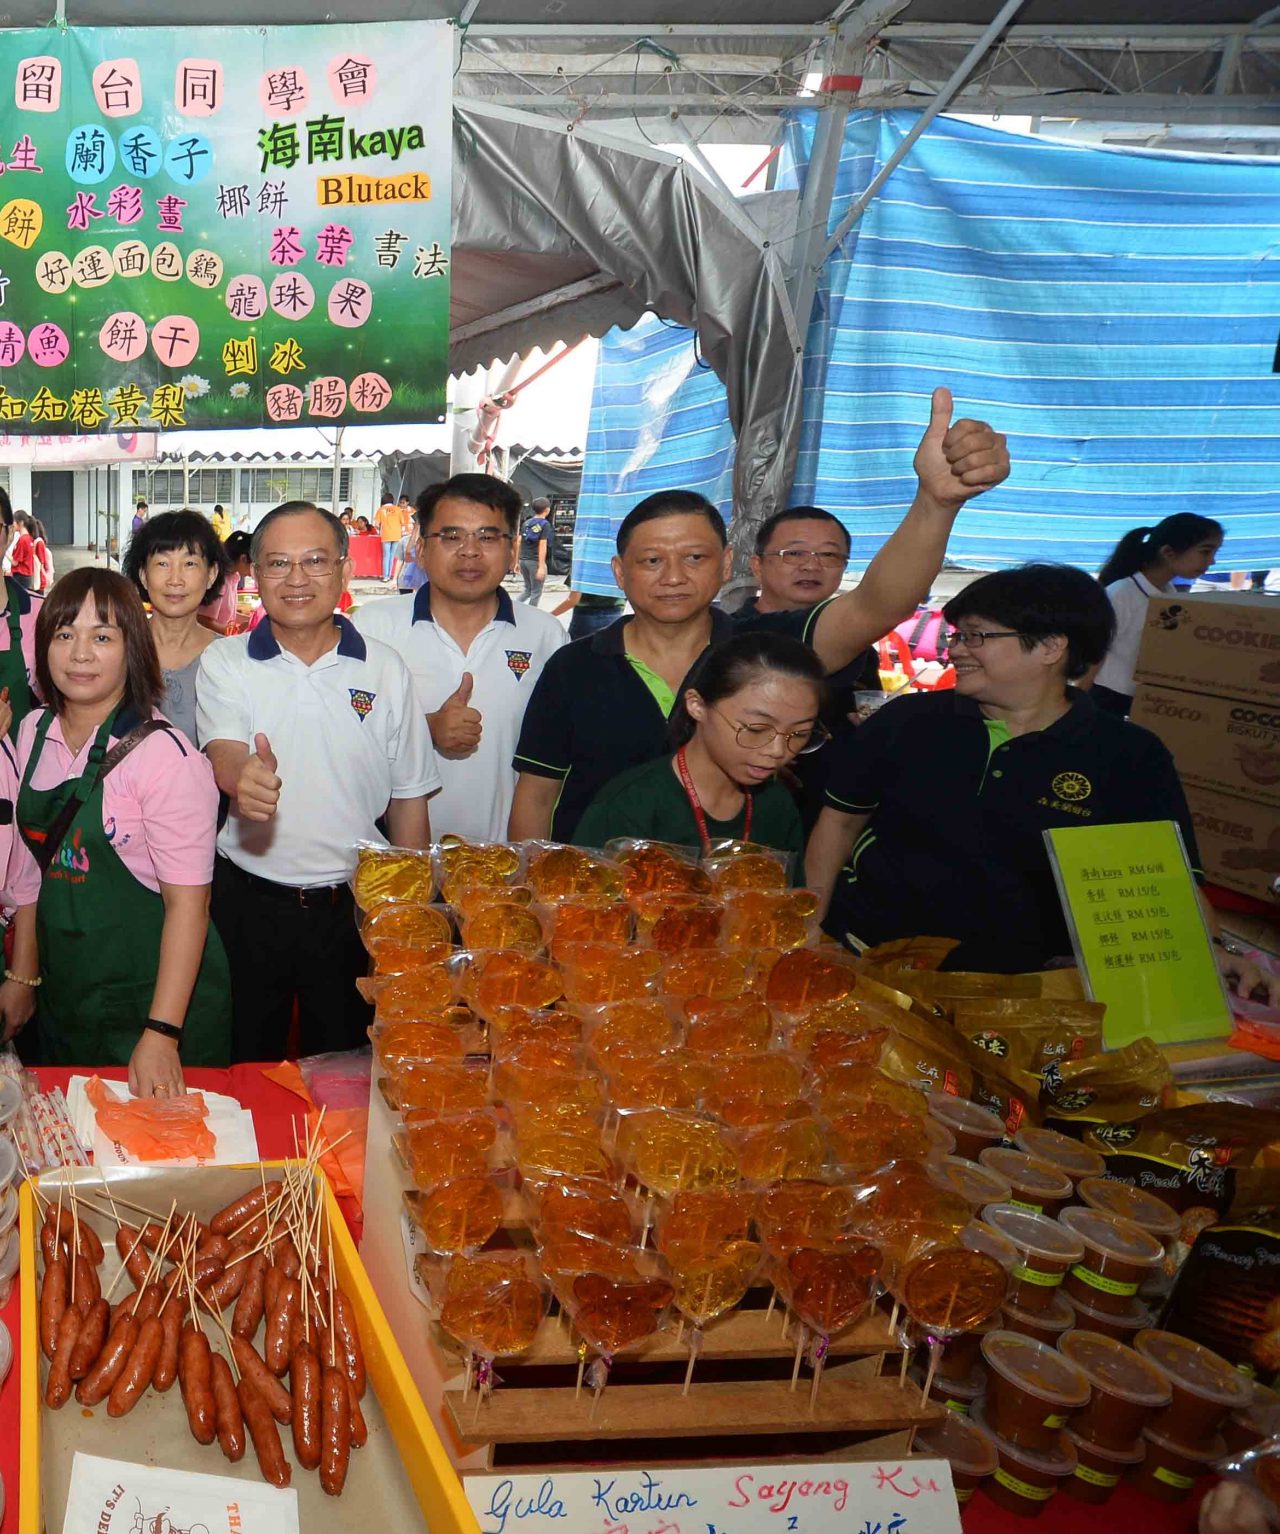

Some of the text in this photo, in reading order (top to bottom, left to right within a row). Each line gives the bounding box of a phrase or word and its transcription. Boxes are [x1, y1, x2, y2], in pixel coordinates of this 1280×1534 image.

[71, 128, 208, 180] 蘭香子
[68, 186, 187, 230] 水彩畫
[217, 181, 289, 219] 椰餅
[321, 174, 427, 206] Blutack
[272, 226, 354, 266] 茶葉
[375, 230, 448, 277] 書法
[230, 282, 367, 320] 龍珠果
[106, 321, 190, 360] 餅干
[268, 378, 387, 418] 豬腸粉
[1128, 864, 1145, 874] RM
[1119, 888, 1136, 898] RM
[1127, 910, 1144, 919] RM
[1131, 932, 1148, 941] RM
[1139, 953, 1155, 963] RM
[484, 1475, 568, 1520] Gula
[591, 1472, 699, 1521] Kartun
[727, 1474, 849, 1514] Sayang
